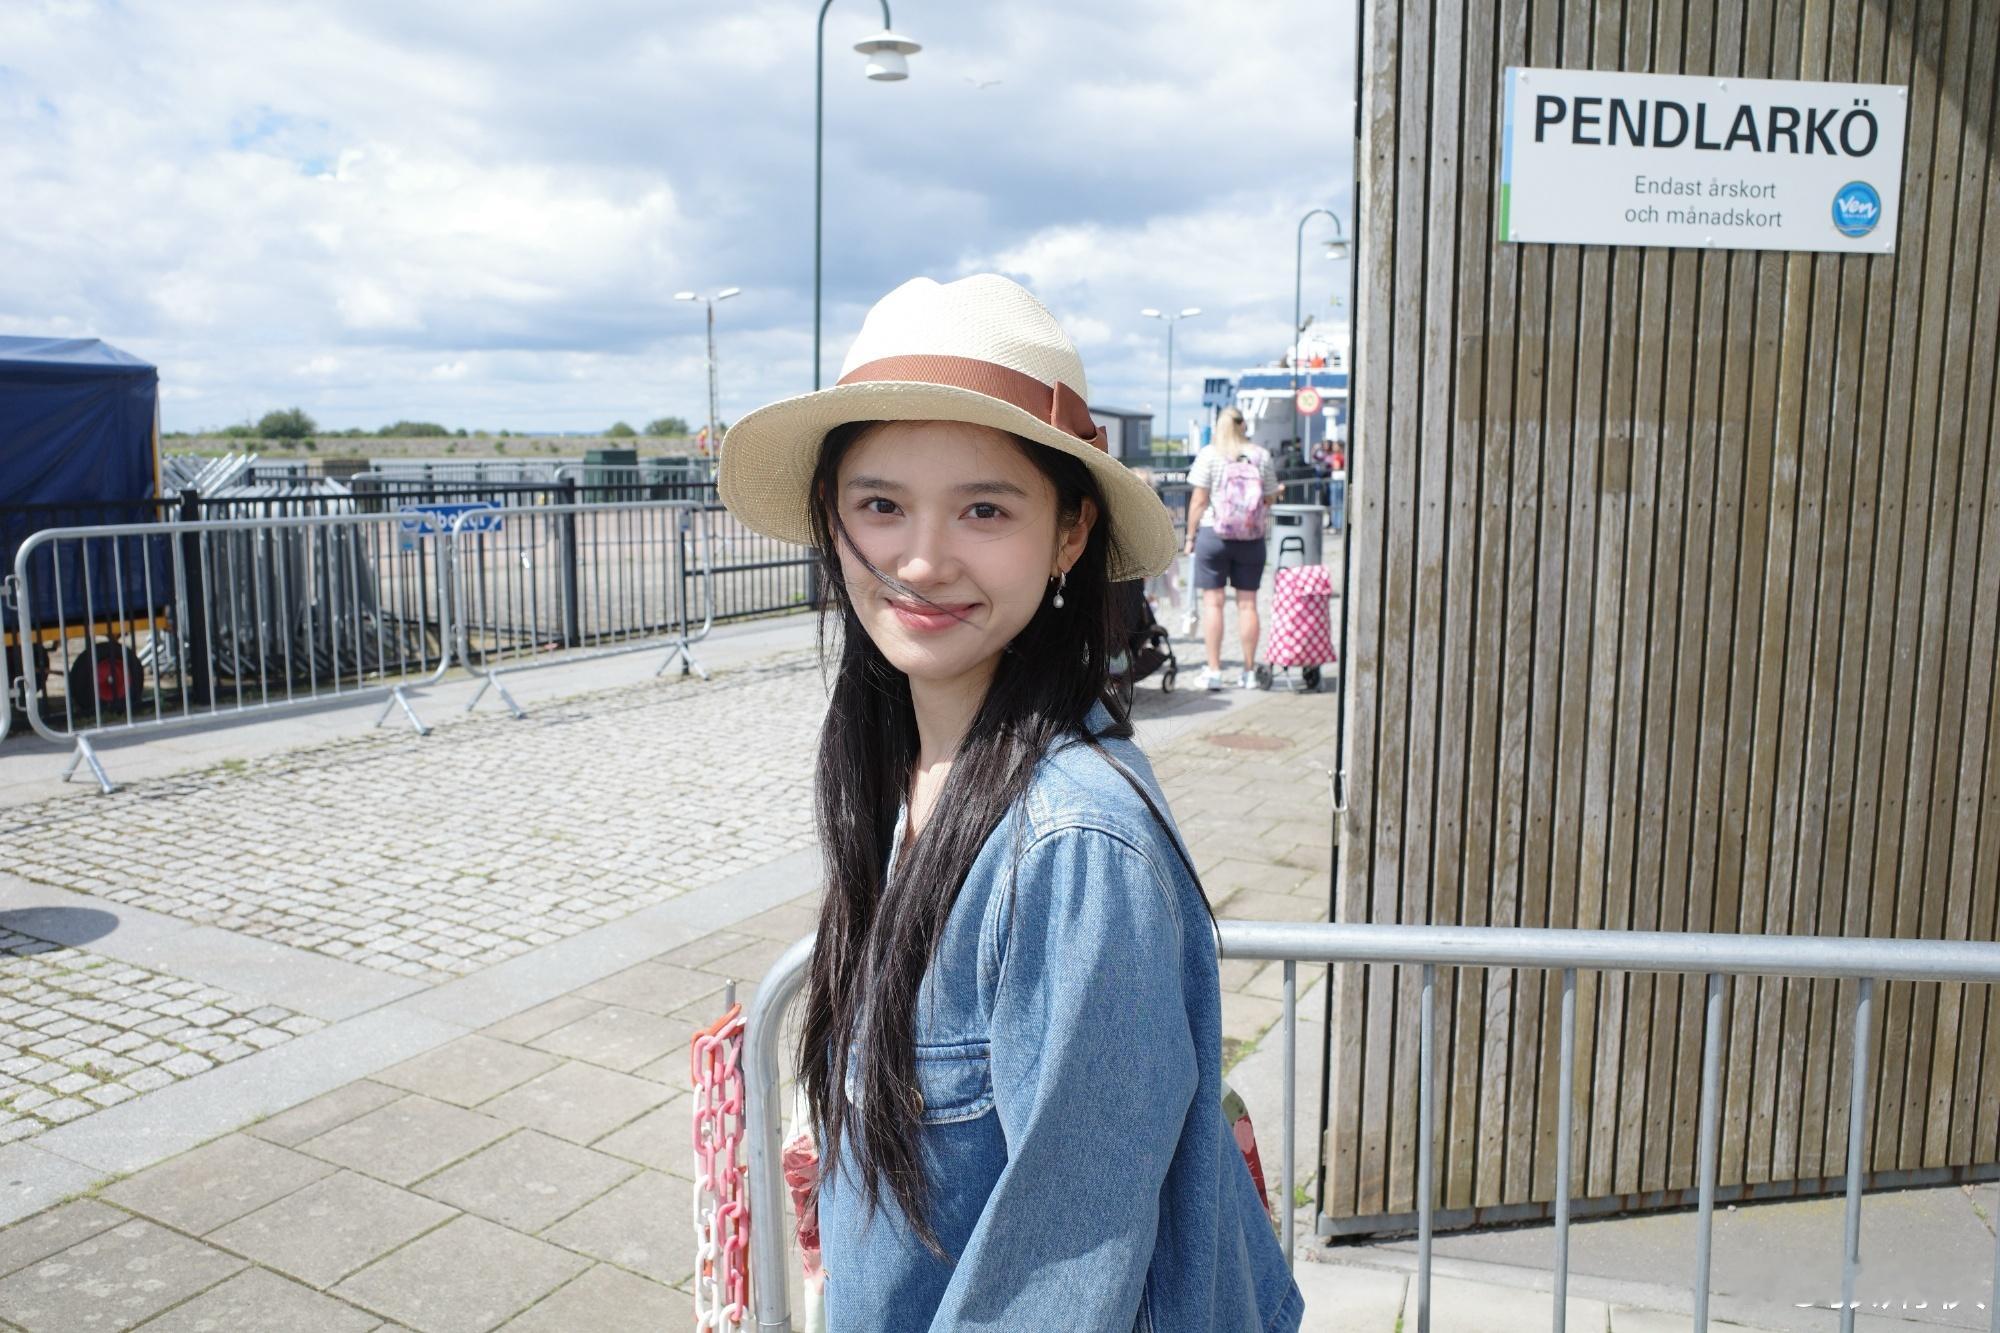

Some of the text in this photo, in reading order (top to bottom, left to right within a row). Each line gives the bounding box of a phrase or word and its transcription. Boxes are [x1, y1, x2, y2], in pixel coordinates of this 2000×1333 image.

[1534, 95, 1879, 158] PENDLARKÖ
[1634, 175, 1776, 199] Endast årskort
[1624, 205, 1782, 228] och månadskort
